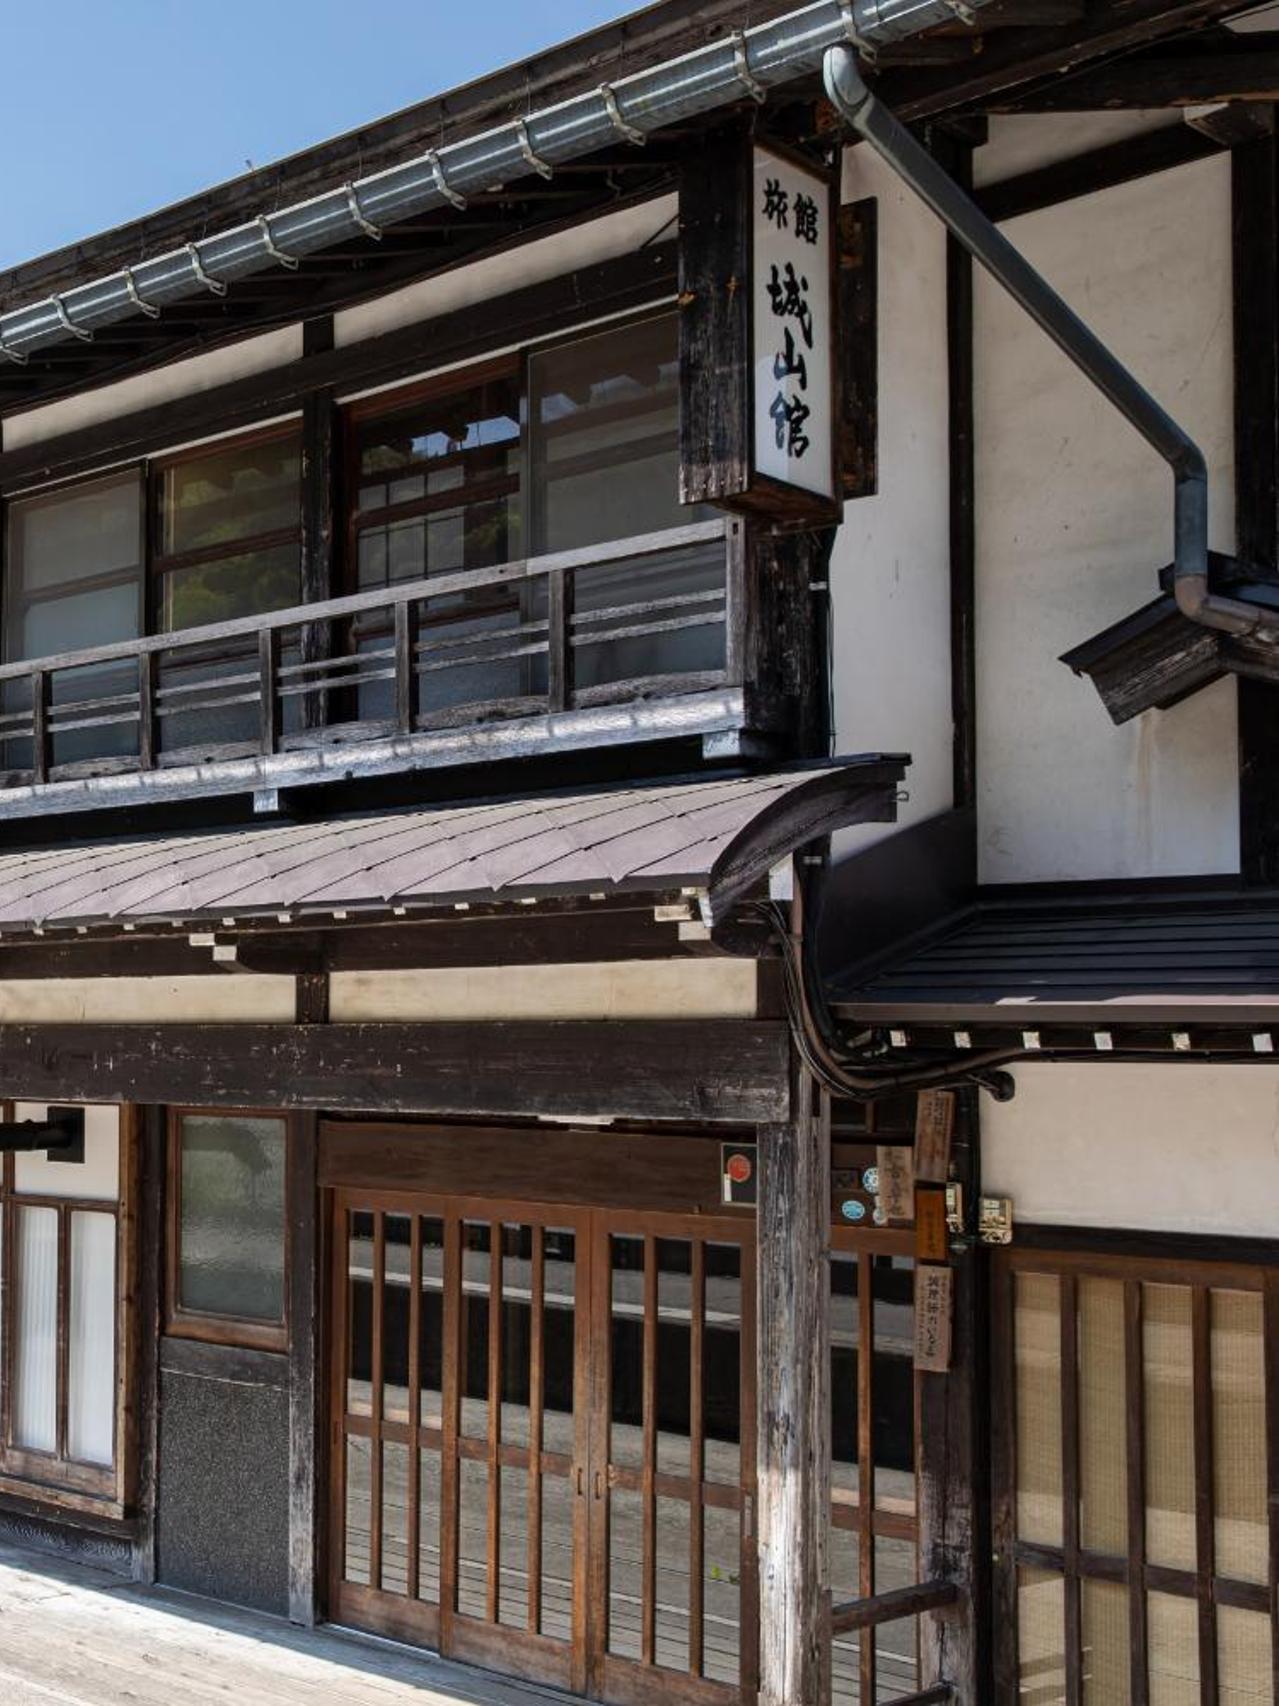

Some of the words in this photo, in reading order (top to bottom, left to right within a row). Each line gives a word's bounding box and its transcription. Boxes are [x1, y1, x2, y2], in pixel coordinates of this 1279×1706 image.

[762, 178, 819, 246] 旅館
[766, 261, 814, 460] 城山館
